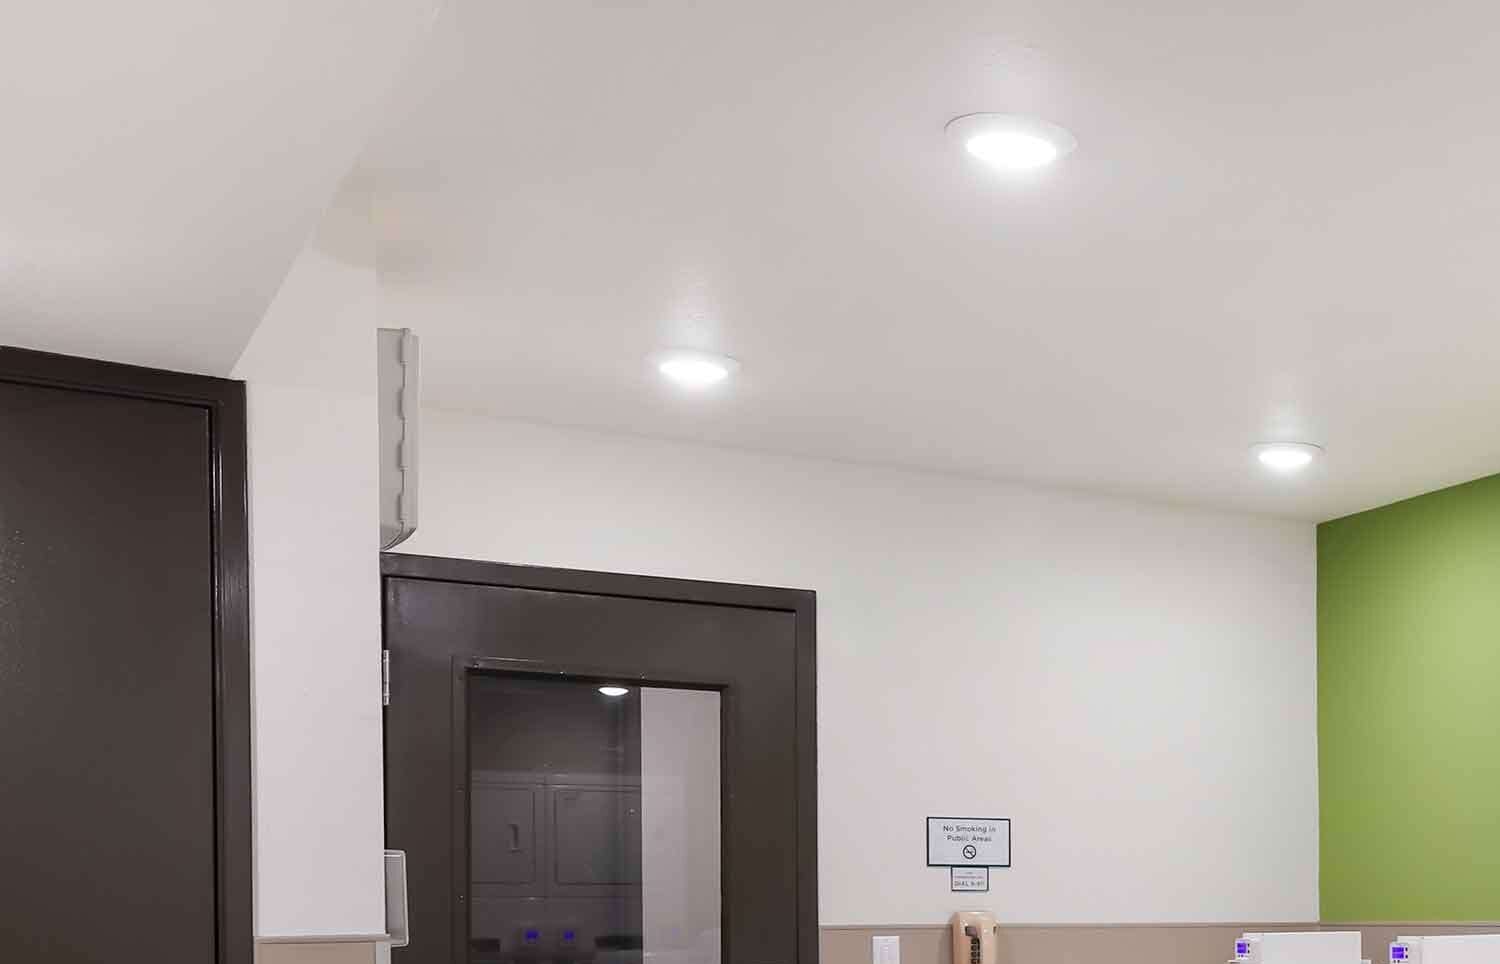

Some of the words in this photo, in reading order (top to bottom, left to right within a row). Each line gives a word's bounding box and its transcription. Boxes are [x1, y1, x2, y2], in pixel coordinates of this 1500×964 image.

[955, 825, 987, 834] Smoking
[947, 834, 970, 842] Public
[971, 834, 993, 842] Areas
